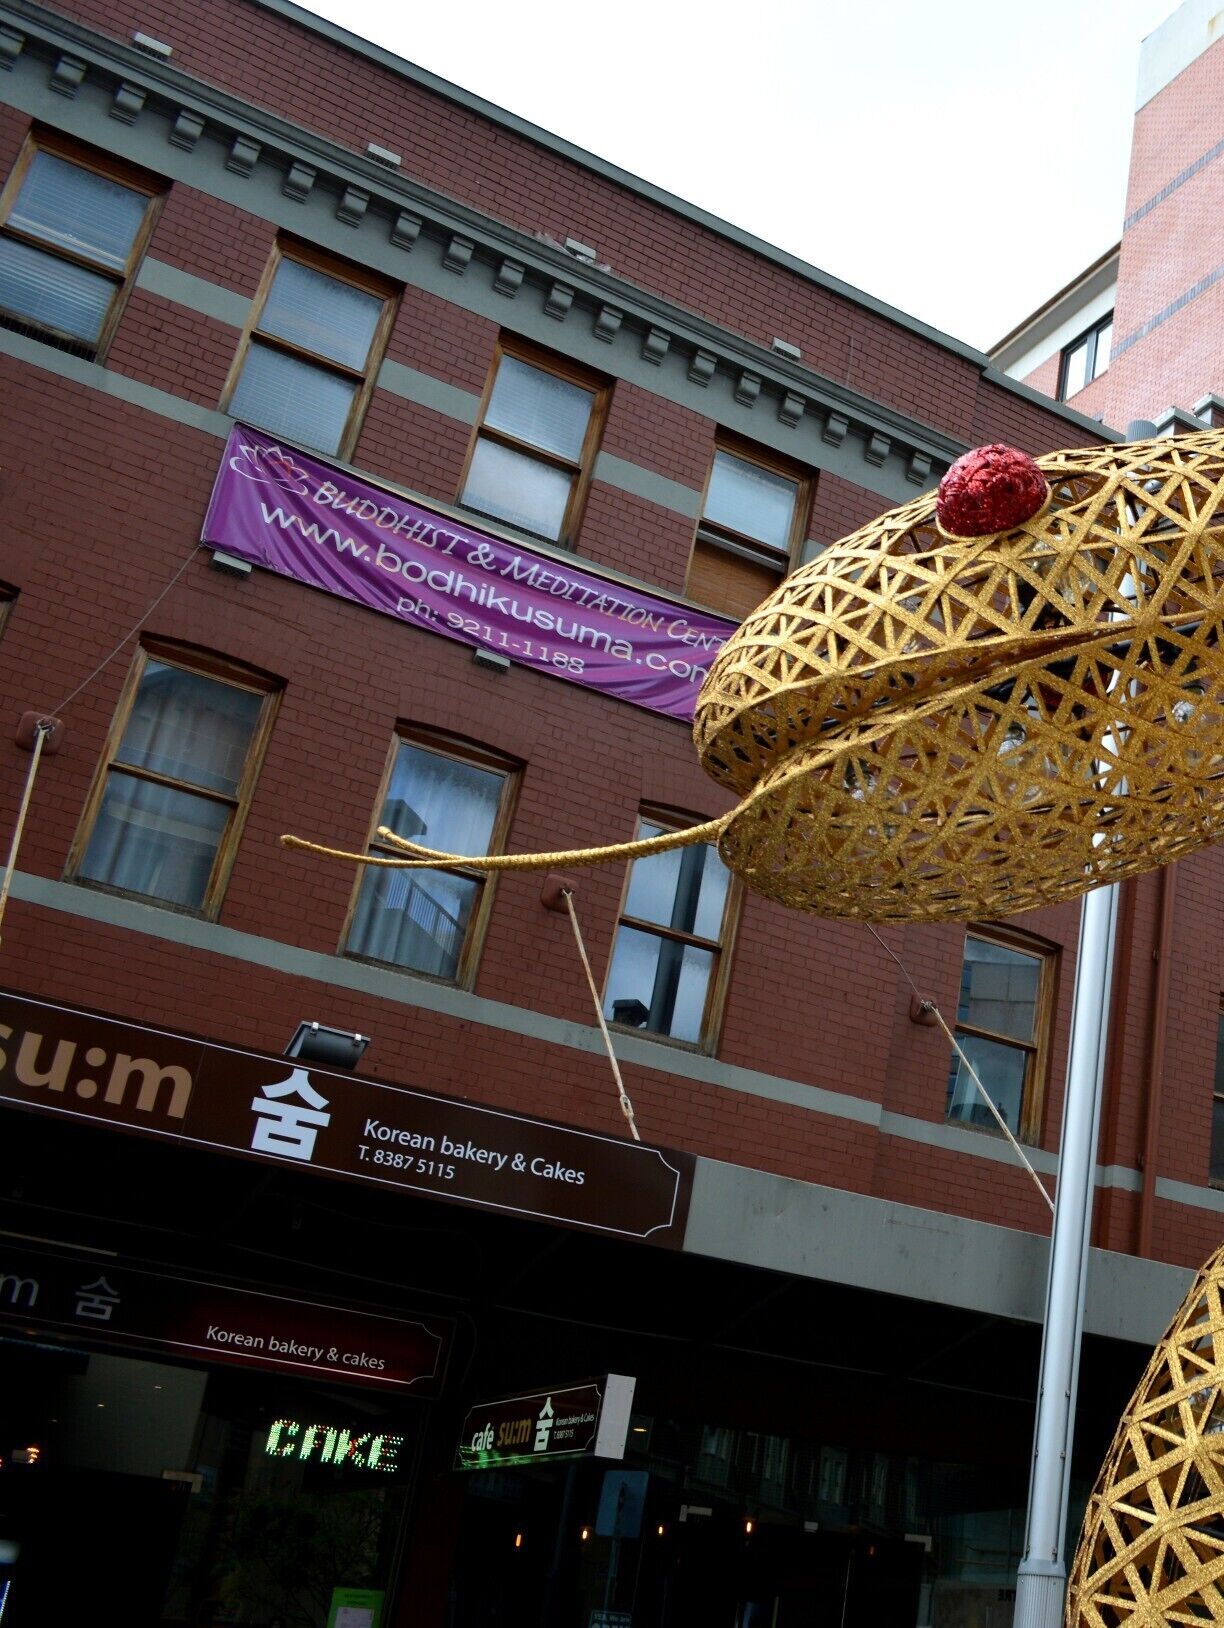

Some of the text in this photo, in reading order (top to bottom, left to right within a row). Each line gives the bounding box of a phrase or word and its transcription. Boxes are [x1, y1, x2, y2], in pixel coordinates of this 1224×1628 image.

[313, 481, 469, 555] BUDDHIST
[467, 543, 496, 570] &
[500, 556, 665, 632] MEDITATION
[396, 596, 585, 674] ph: 9211-1188
[0, 1023, 192, 1119] u:m
[250, 1068, 331, 1161] 숨
[358, 1144, 456, 1180] T. 8387 5115
[363, 1118, 585, 1185] Korean bakery & Cakes
[75, 1275, 121, 1321] 숨
[206, 1325, 385, 1370] Korean bakery & cakes
[265, 1418, 404, 1473] CAKE
[533, 1396, 554, 1452] 숨
